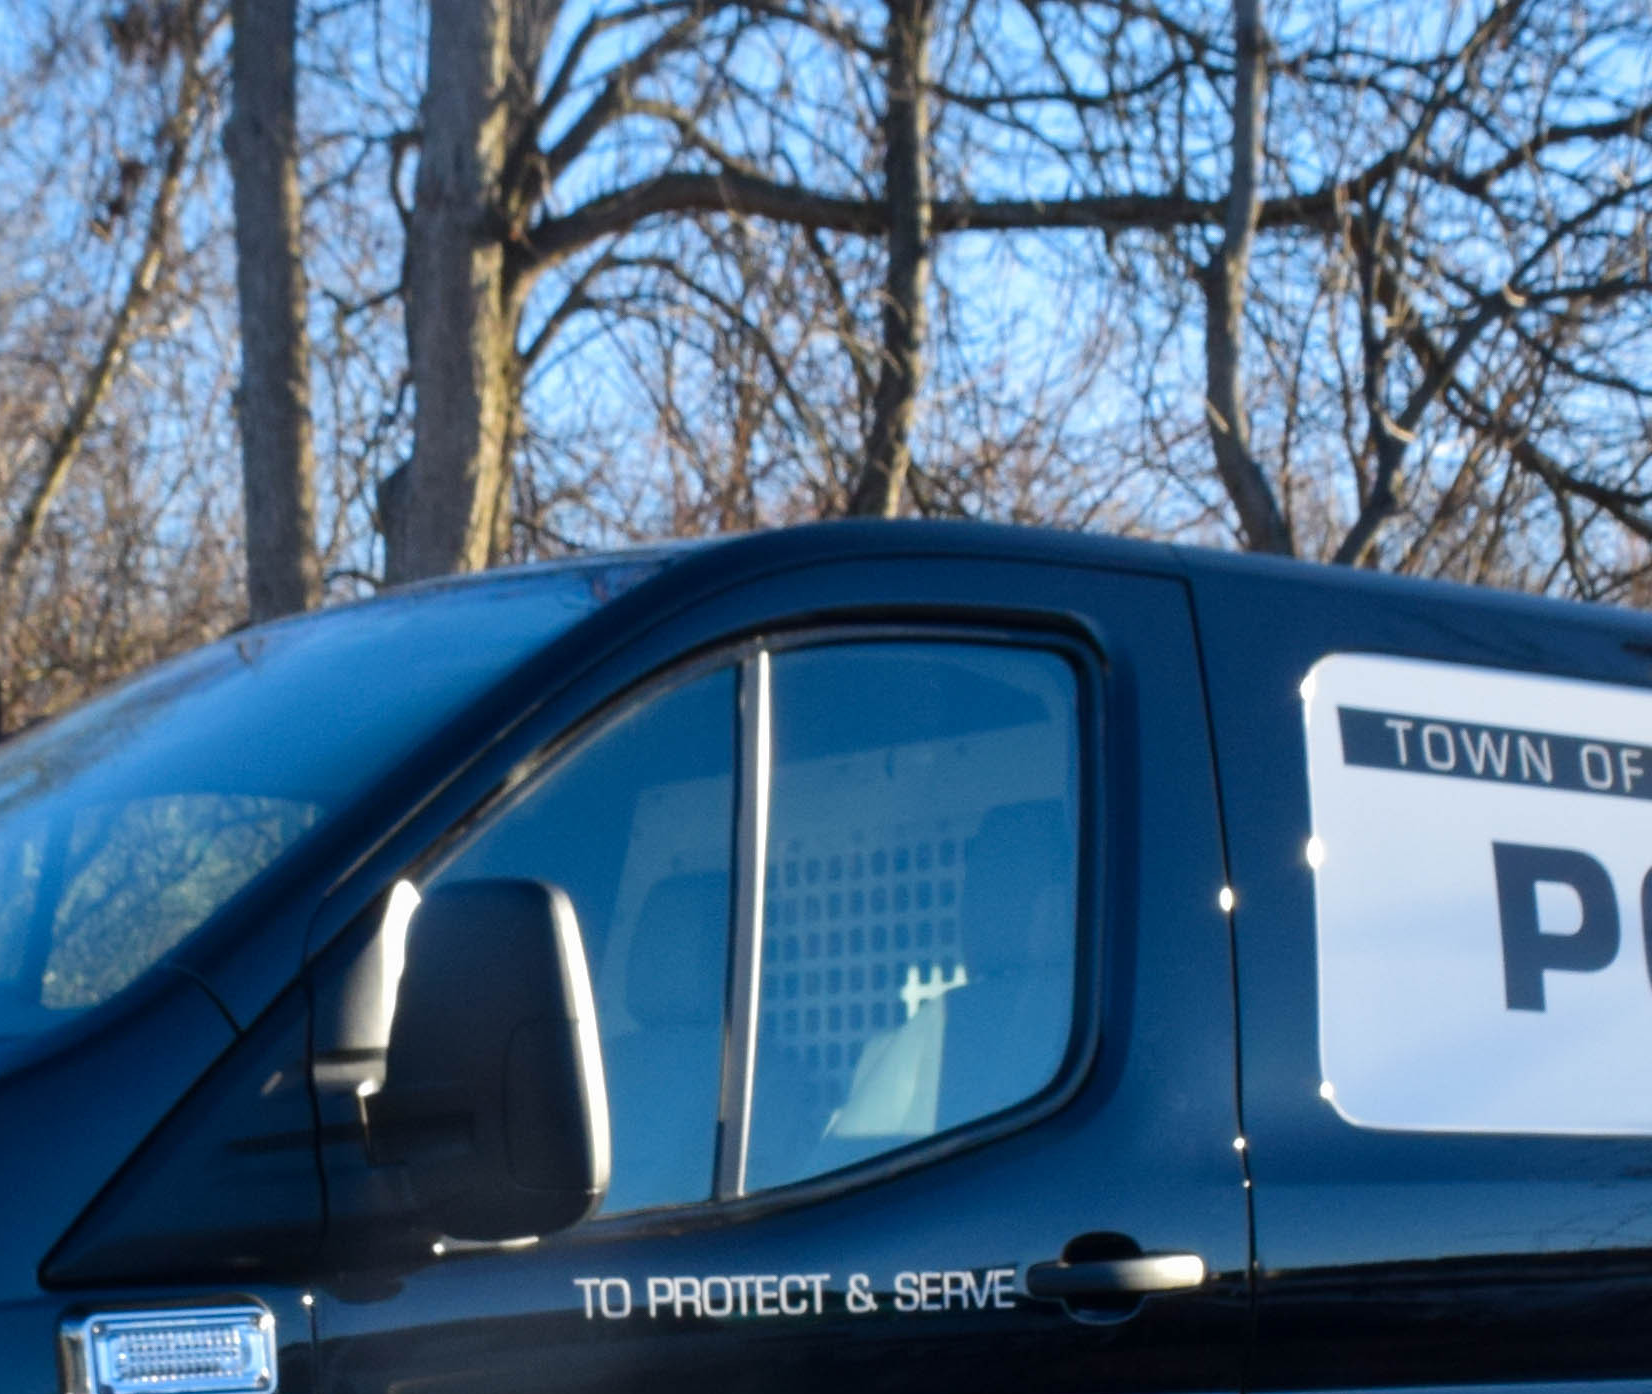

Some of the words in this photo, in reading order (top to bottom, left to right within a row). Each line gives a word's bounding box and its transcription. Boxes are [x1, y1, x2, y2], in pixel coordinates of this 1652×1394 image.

[1385, 718, 1552, 783] TOWN
[1580, 743, 1644, 793] OF
[573, 1276, 632, 1320] TO
[647, 1272, 830, 1318] PROTECT
[846, 1272, 878, 1314] &
[893, 1268, 1016, 1312] SERVE
